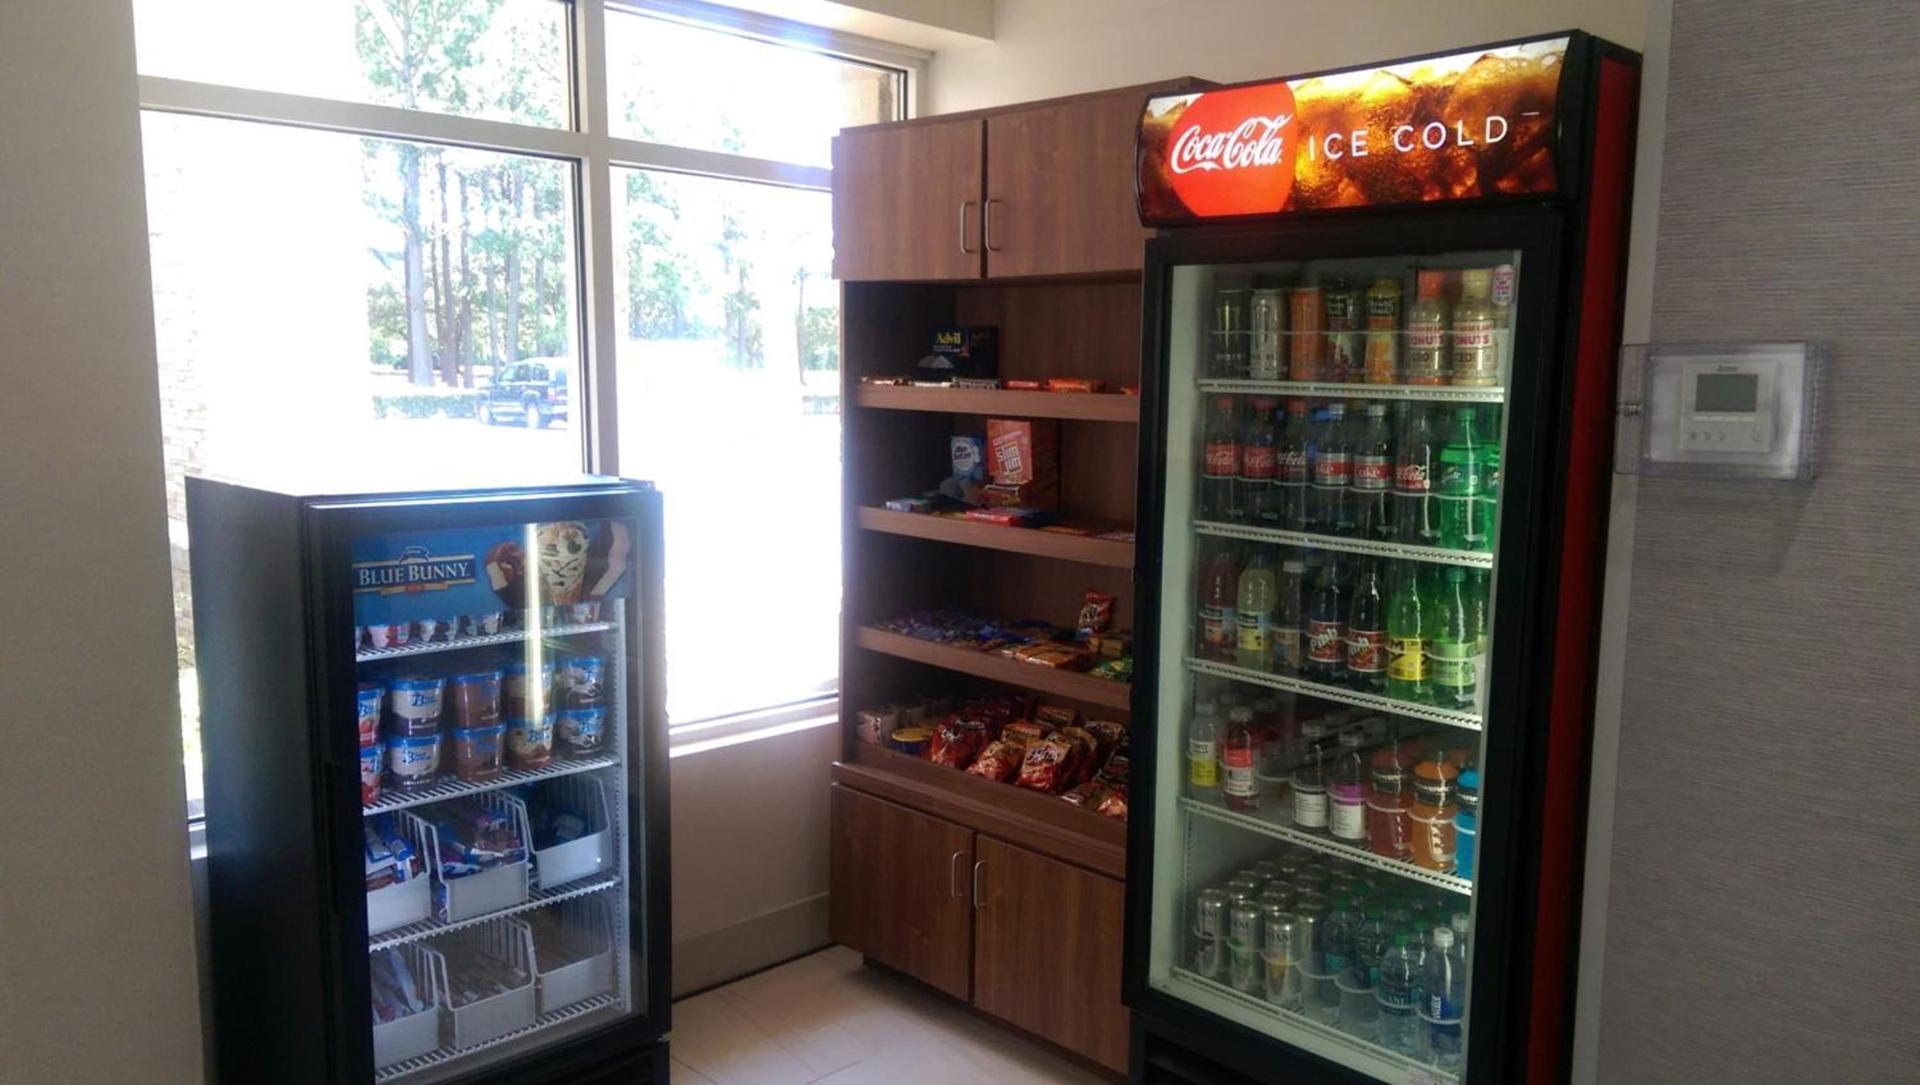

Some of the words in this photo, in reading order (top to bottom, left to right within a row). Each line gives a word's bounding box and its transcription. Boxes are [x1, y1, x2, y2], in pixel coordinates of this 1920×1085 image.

[1171, 113, 1292, 175] Coca-Cola
[1307, 129, 1369, 161] ICE
[1393, 115, 1509, 153] COLD
[359, 566, 405, 586] BLUE
[408, 562, 469, 583] BUNNY
